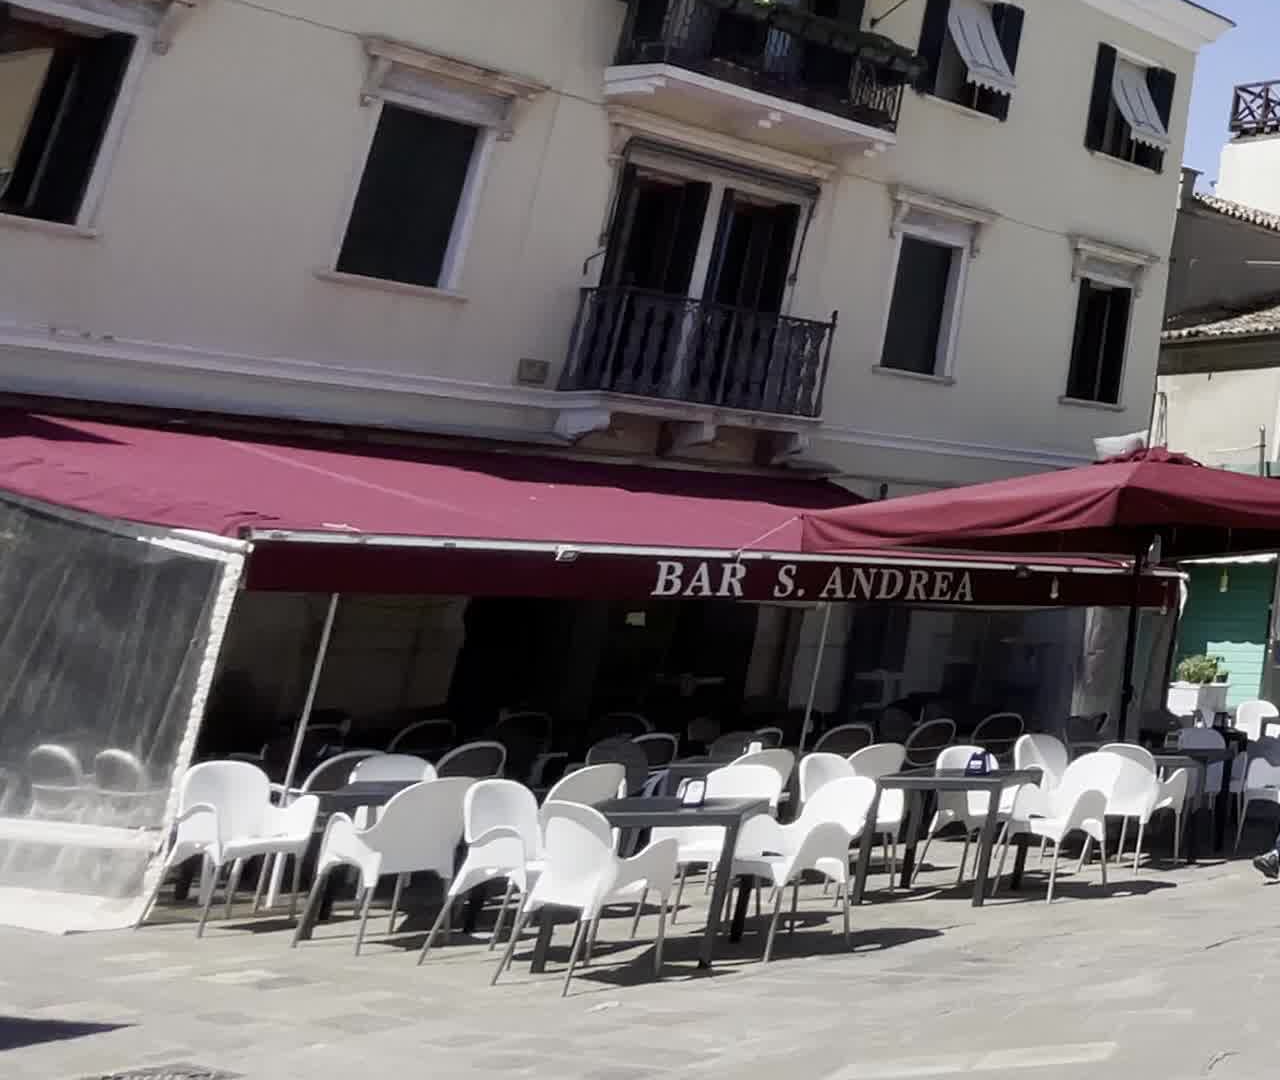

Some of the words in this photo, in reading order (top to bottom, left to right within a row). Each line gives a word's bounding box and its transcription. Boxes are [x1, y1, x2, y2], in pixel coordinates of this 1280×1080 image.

[650, 560, 747, 596] BAR
[773, 564, 805, 597] S.
[819, 568, 975, 601] ANDREA
